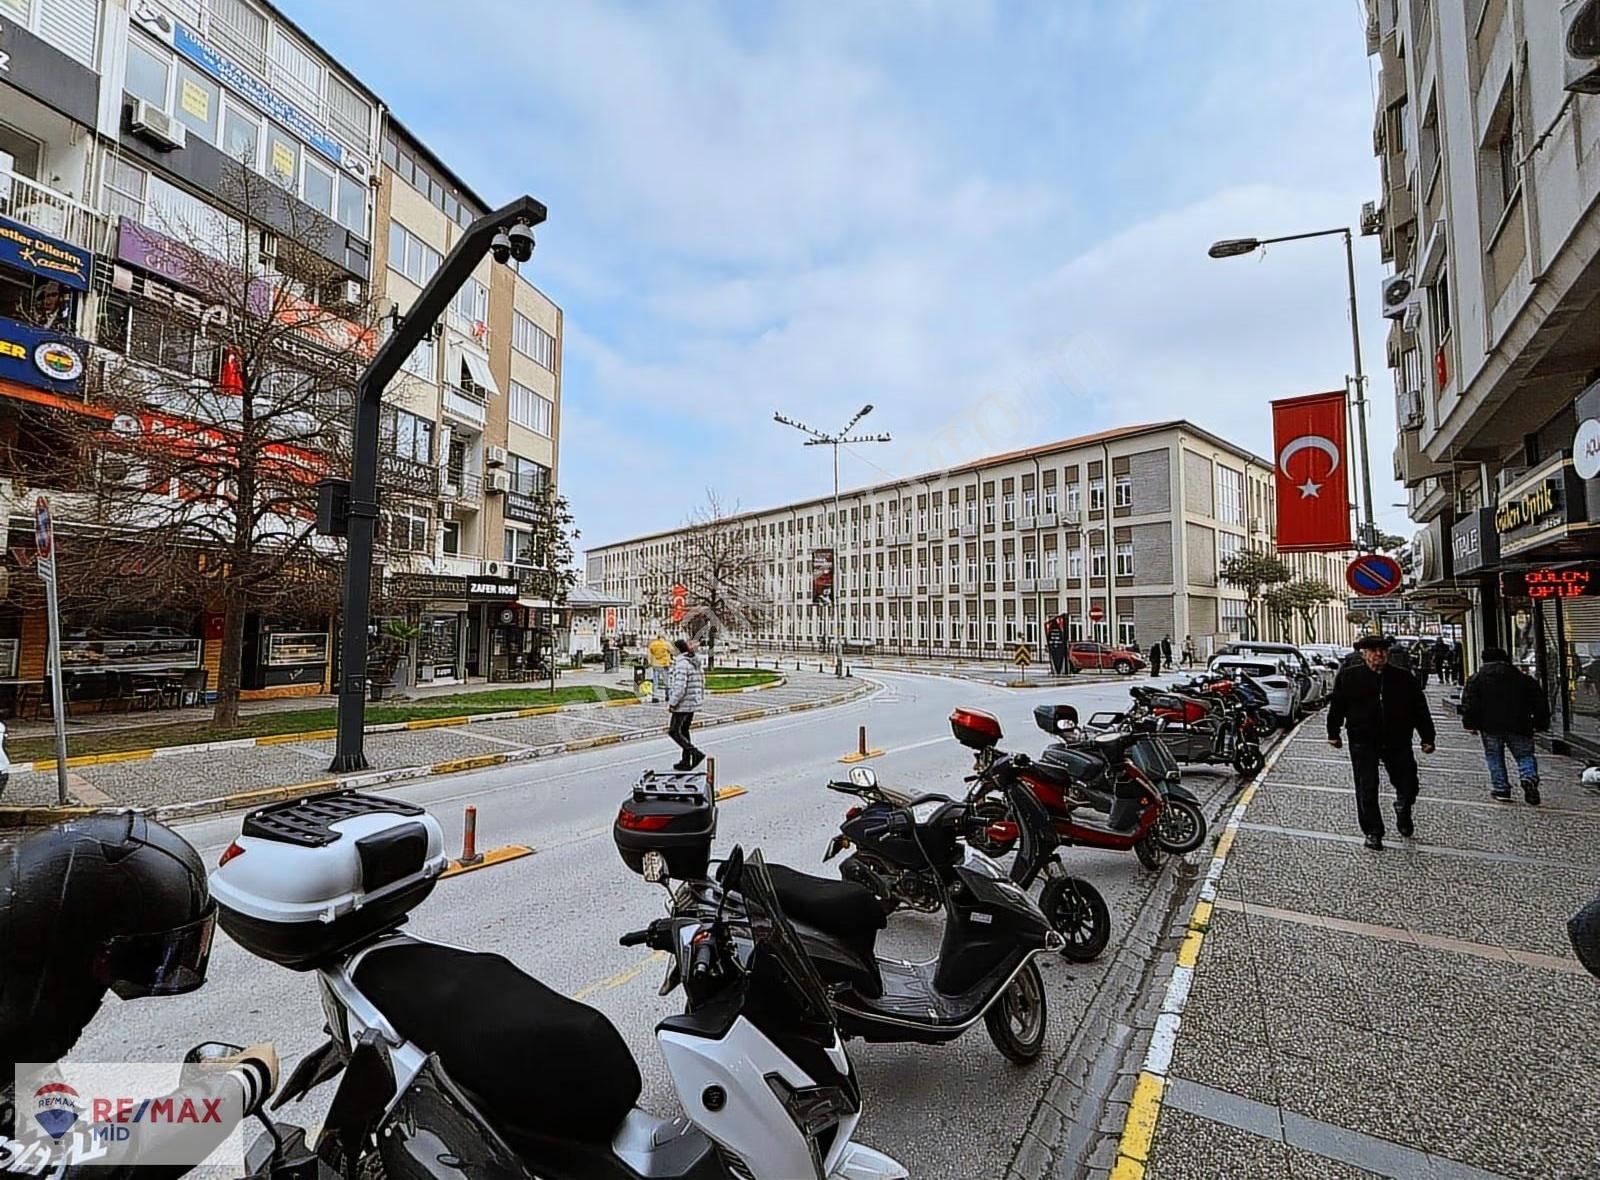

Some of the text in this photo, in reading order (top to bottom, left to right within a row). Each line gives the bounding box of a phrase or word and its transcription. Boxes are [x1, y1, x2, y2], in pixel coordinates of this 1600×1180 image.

[382, 457, 433, 481] AVUKAT
[1521, 479, 1554, 528] Optik
[470, 583, 497, 594] ZAFER
[498, 584, 518, 595] HOBİ
